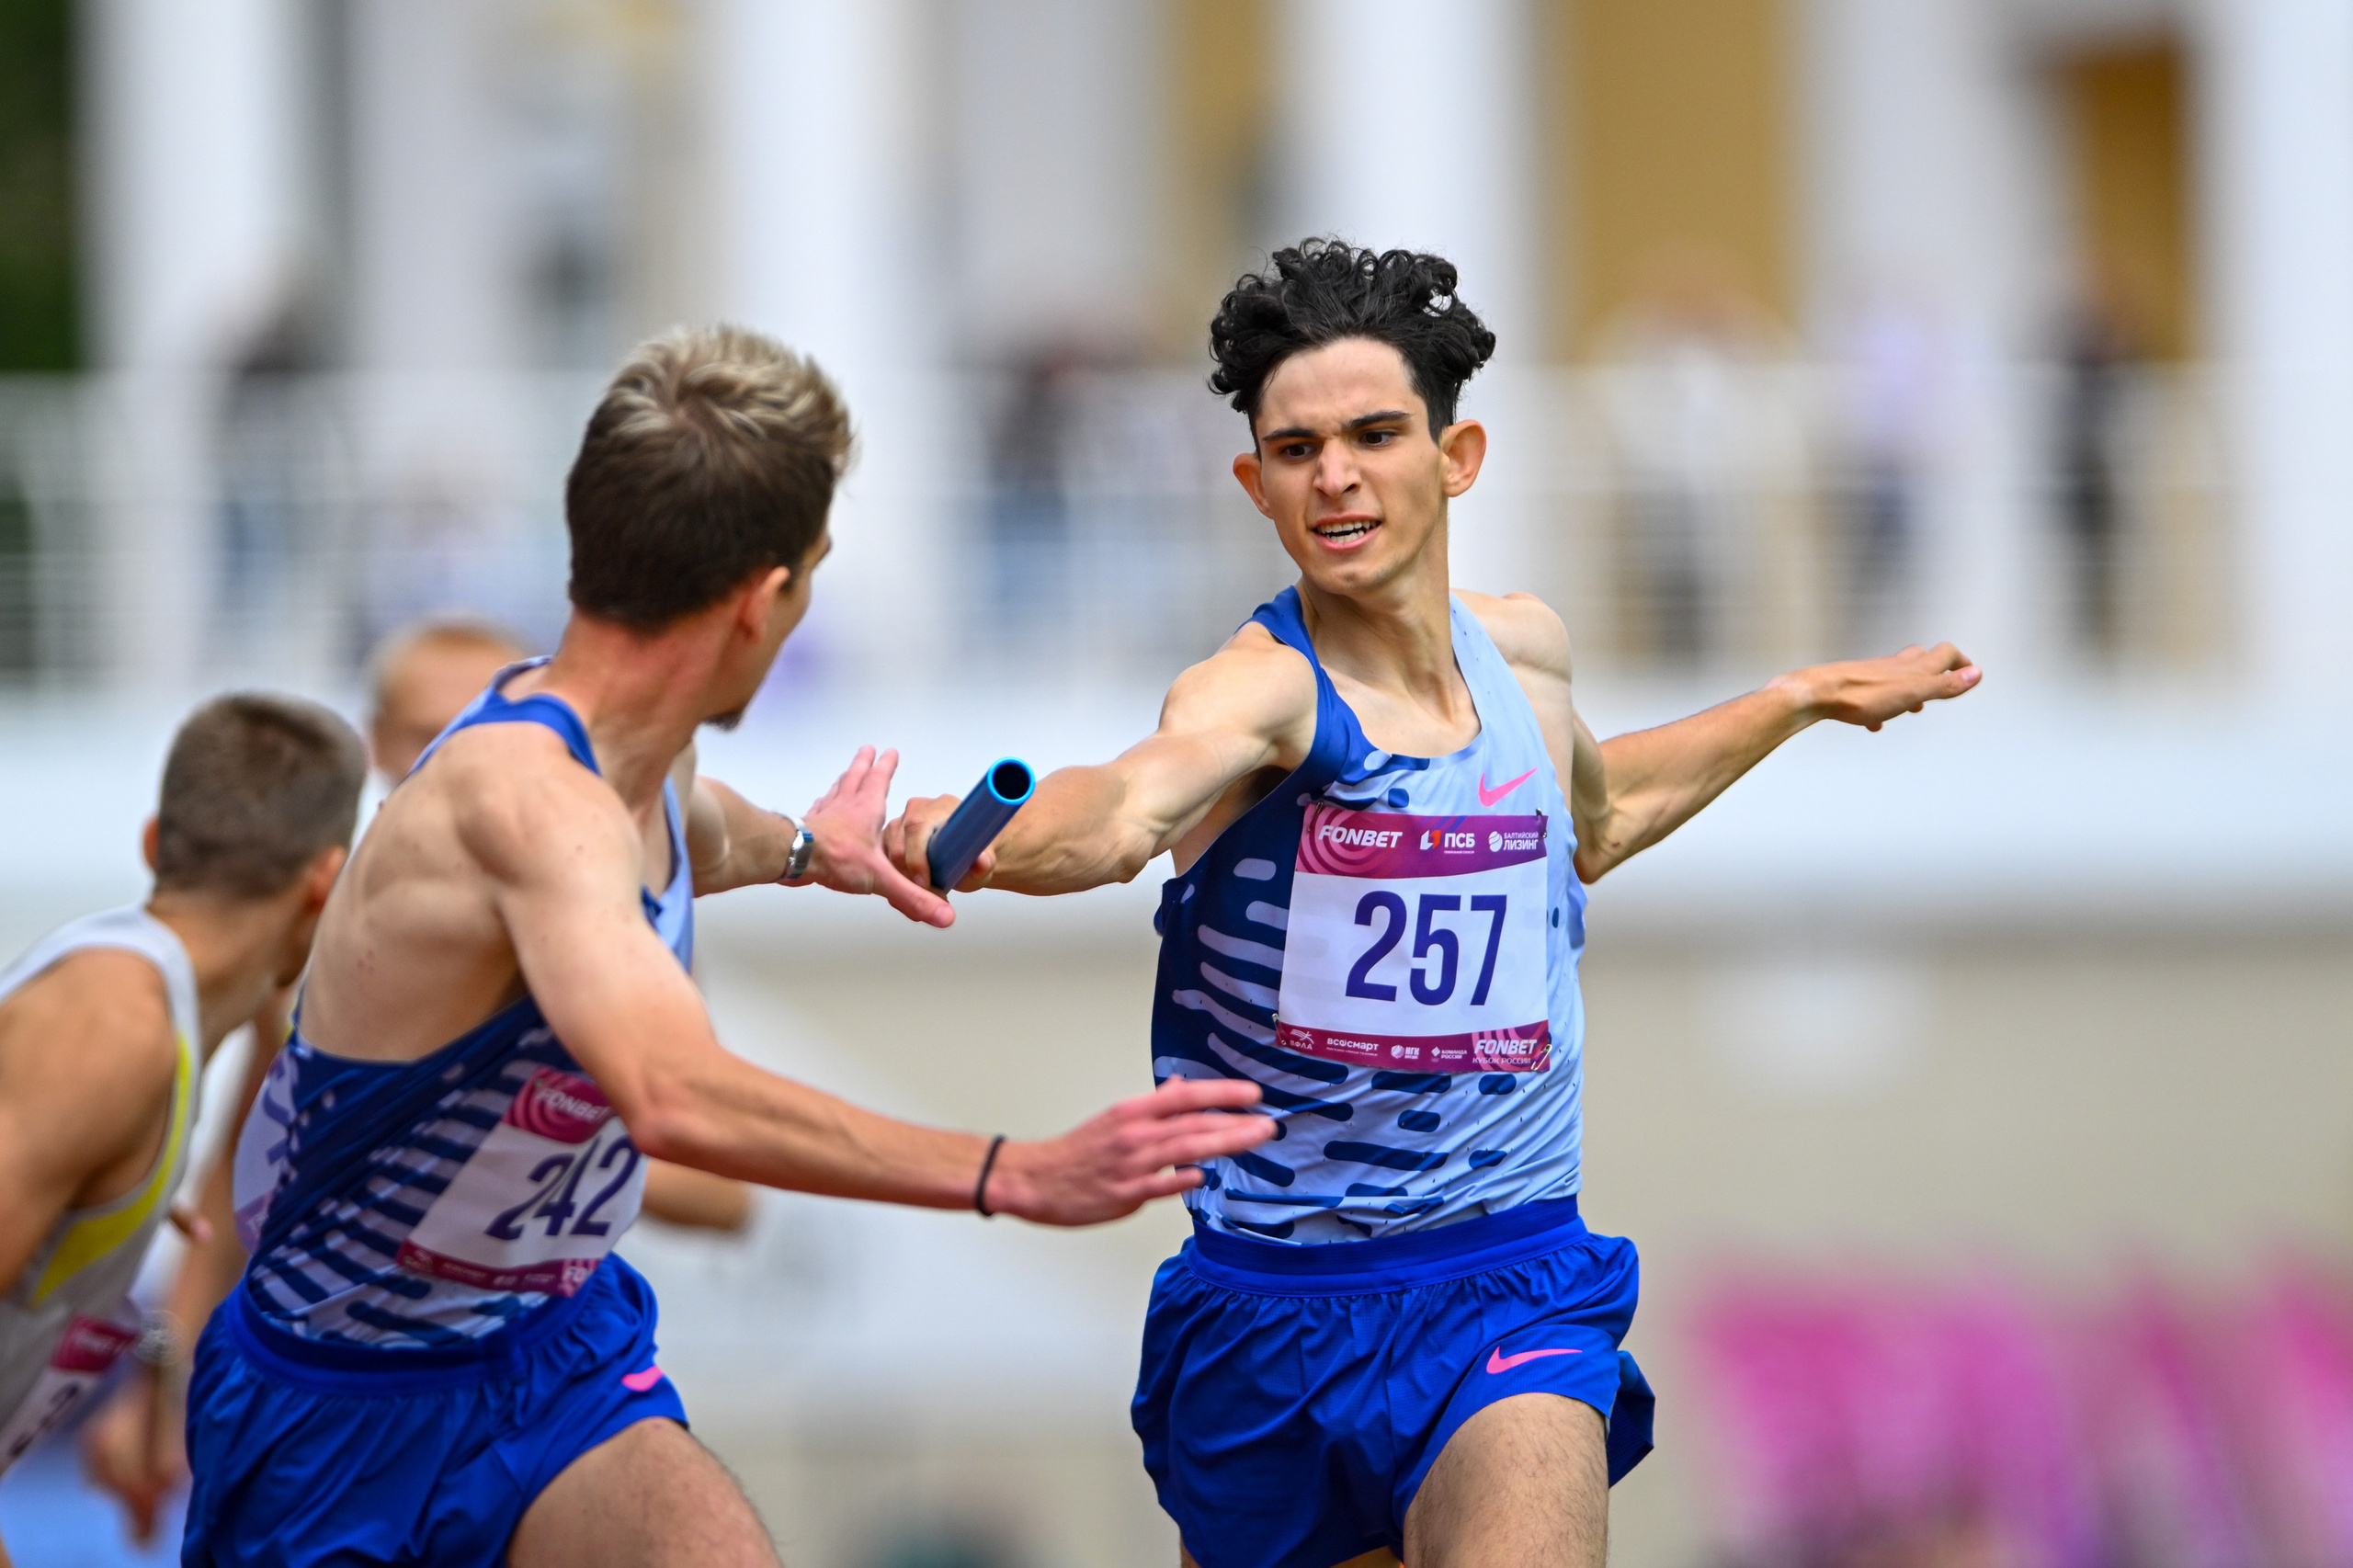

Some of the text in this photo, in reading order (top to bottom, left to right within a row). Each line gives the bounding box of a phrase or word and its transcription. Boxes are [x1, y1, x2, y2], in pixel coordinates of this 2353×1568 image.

[1318, 825, 1403, 848] FONBET
[1444, 833, 1475, 847] ПСБ
[1504, 831, 1539, 839] БАЛТИЙСКИЙ
[1503, 839, 1539, 850] ЛИЗИНГ
[1345, 890, 1507, 1006] 257
[1474, 1040, 1538, 1055] FONBET
[484, 1134, 641, 1240] 242
